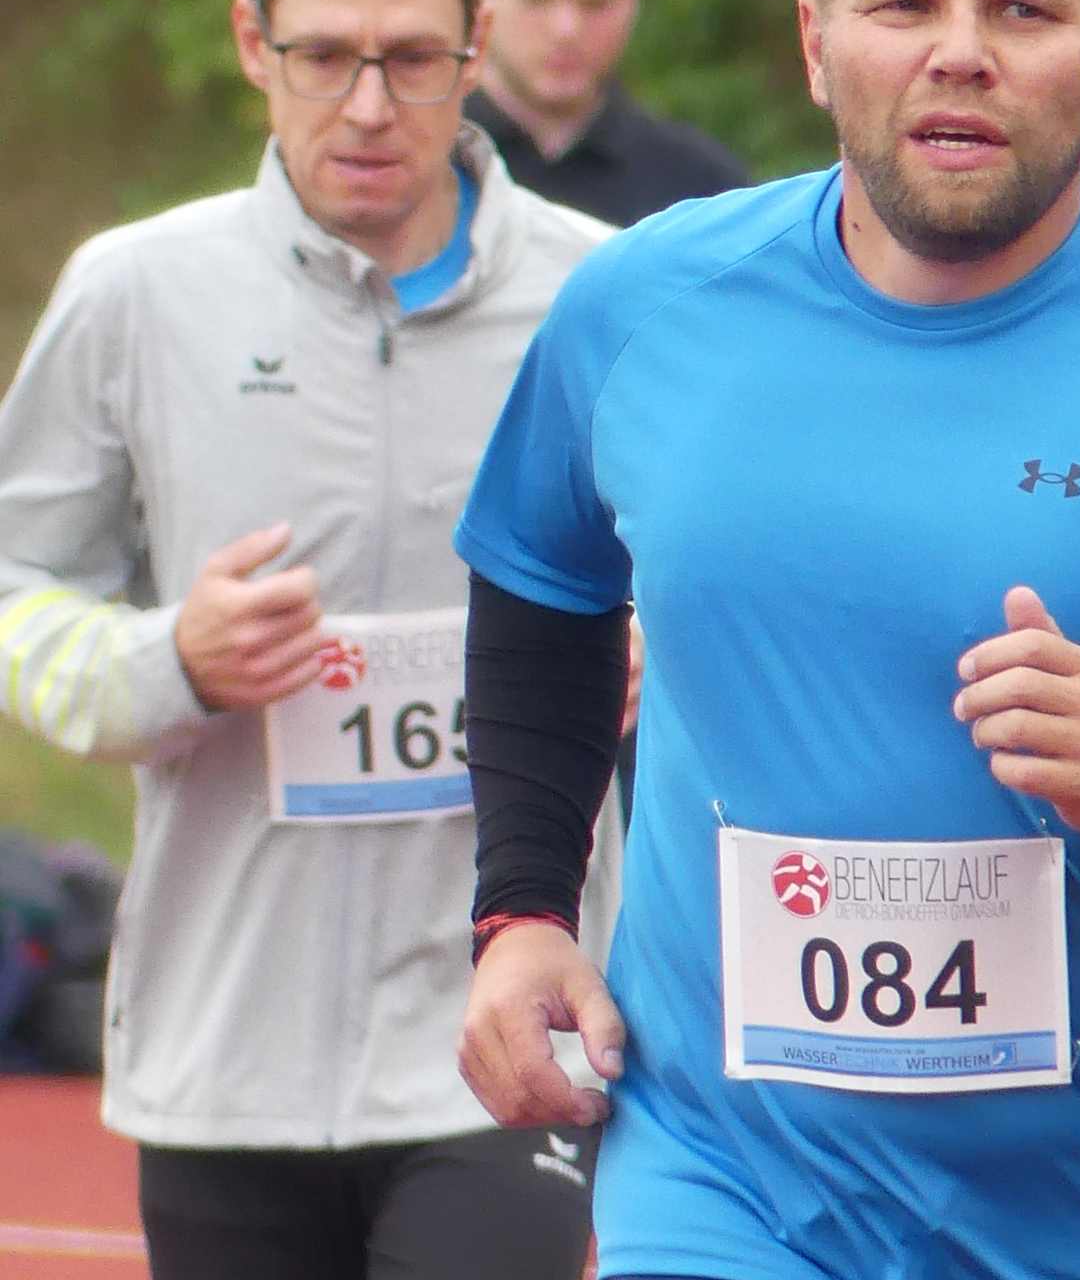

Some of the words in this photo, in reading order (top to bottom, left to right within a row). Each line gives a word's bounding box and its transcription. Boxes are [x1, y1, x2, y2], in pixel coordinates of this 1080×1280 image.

[834, 854, 1008, 903] BENEFIZLAUF
[801, 937, 987, 1026] 084
[783, 1046, 838, 1065] WASSER
[905, 1053, 991, 1070] WERTHEIM
